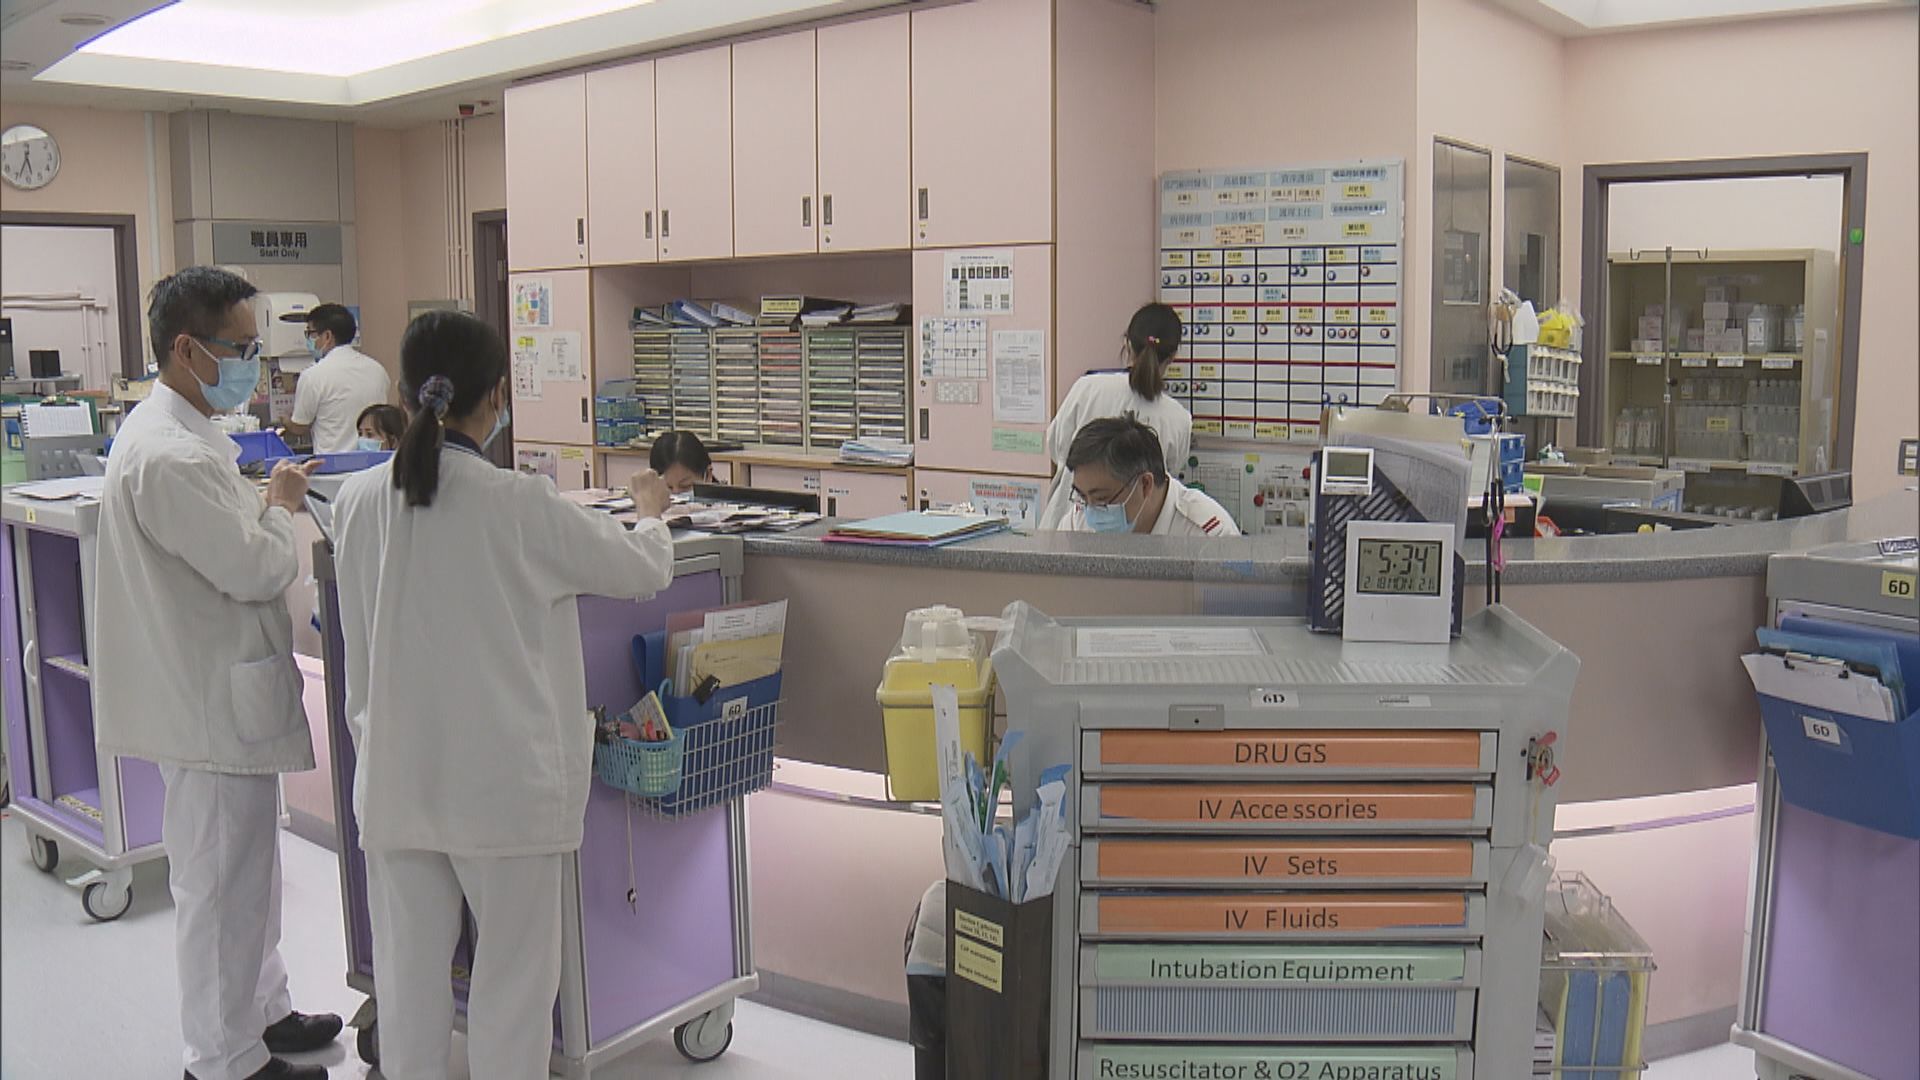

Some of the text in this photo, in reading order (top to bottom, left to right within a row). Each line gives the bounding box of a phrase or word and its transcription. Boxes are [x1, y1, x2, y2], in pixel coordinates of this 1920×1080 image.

[251, 230, 307, 248] 職員專用
[260, 248, 300, 260] Staff Only
[1379, 544, 1428, 575] 5:34
[1889, 580, 1909, 595] 6D
[1262, 693, 1286, 704] 6D
[728, 704, 741, 717] 6D
[1813, 723, 1829, 737] 6D
[1235, 742, 1326, 763] DRUGS
[1199, 798, 1377, 819] IV Accessories
[1244, 856, 1337, 875] IV Sets
[1225, 907, 1338, 929] IV Fluids
[1151, 958, 1415, 983] Intubation Equipment
[1100, 1058, 1441, 1080] Resuscitator & O2 Apparatus
